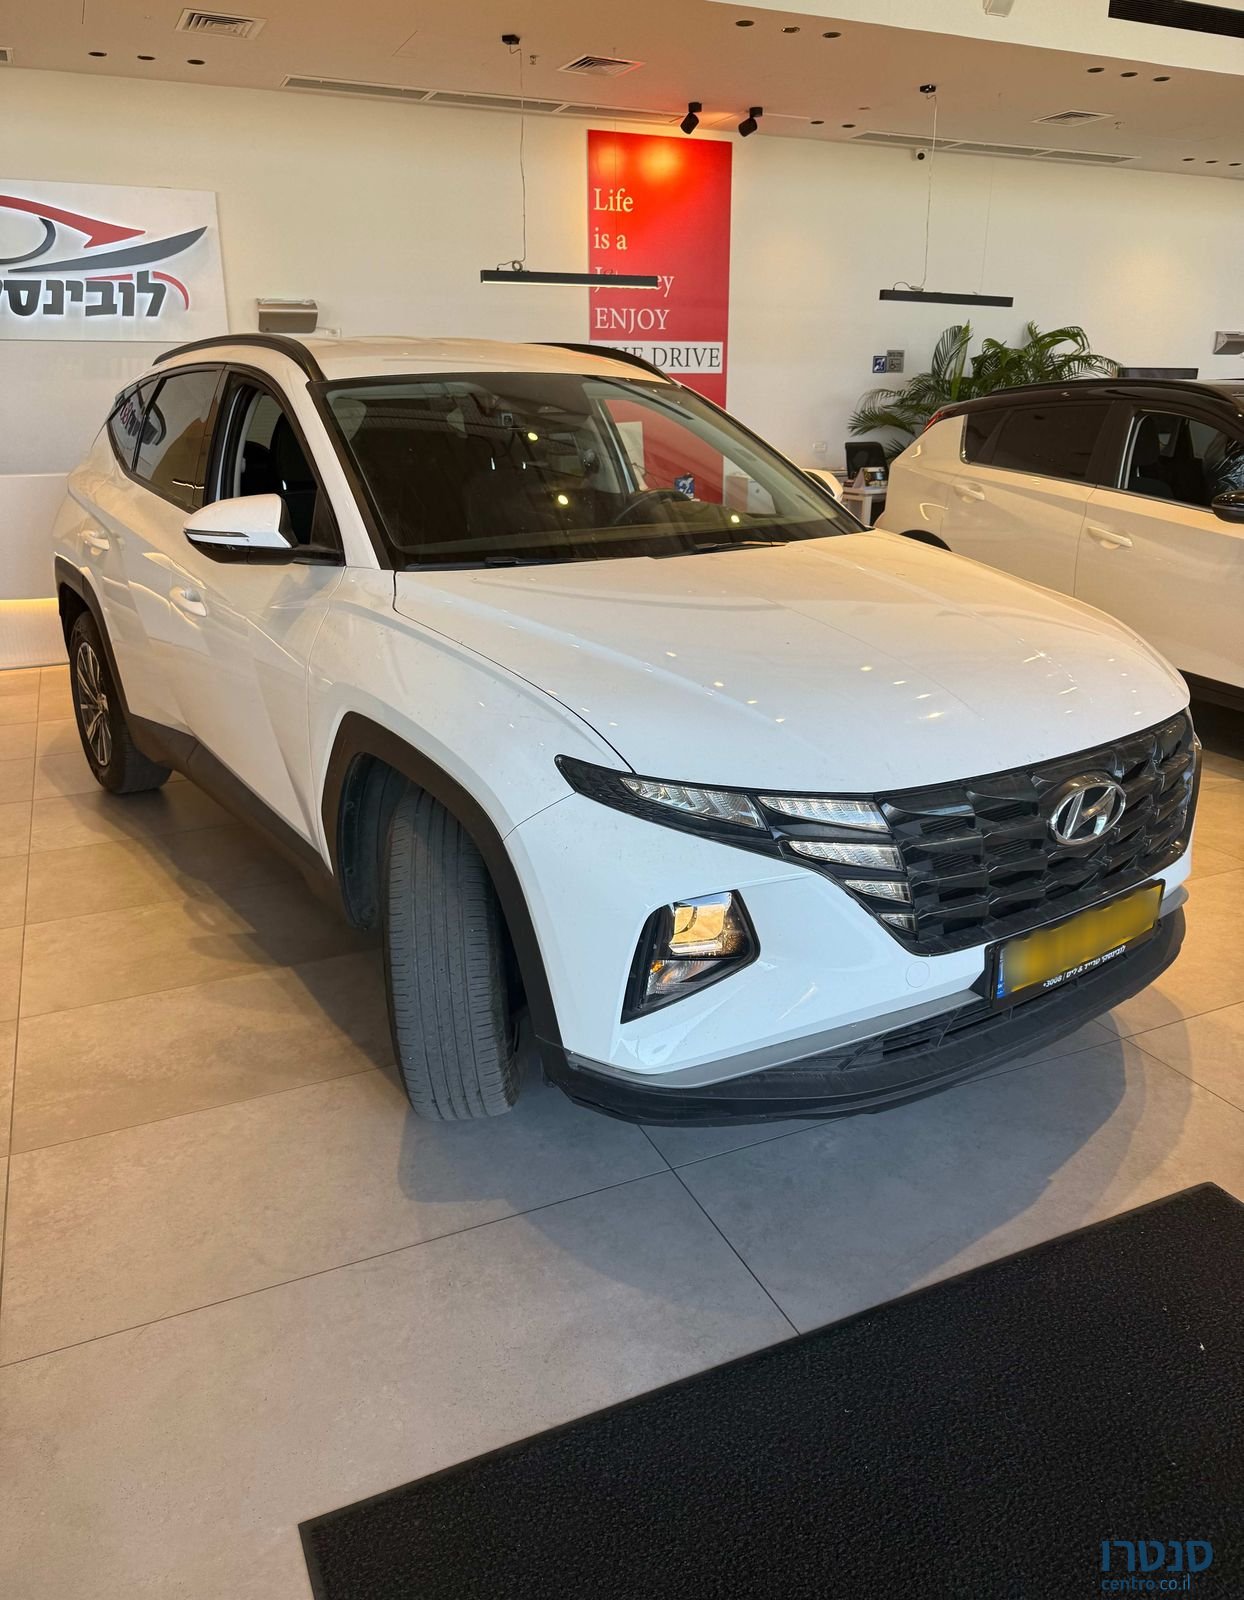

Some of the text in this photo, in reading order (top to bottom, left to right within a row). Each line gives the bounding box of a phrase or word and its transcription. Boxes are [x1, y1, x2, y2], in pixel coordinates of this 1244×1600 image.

[593, 188, 634, 213] Life
[593, 227, 628, 251] is a
[0, 270, 167, 317] לובינס
[594, 307, 670, 334] ENJOY
[652, 347, 721, 368] DRIVE
